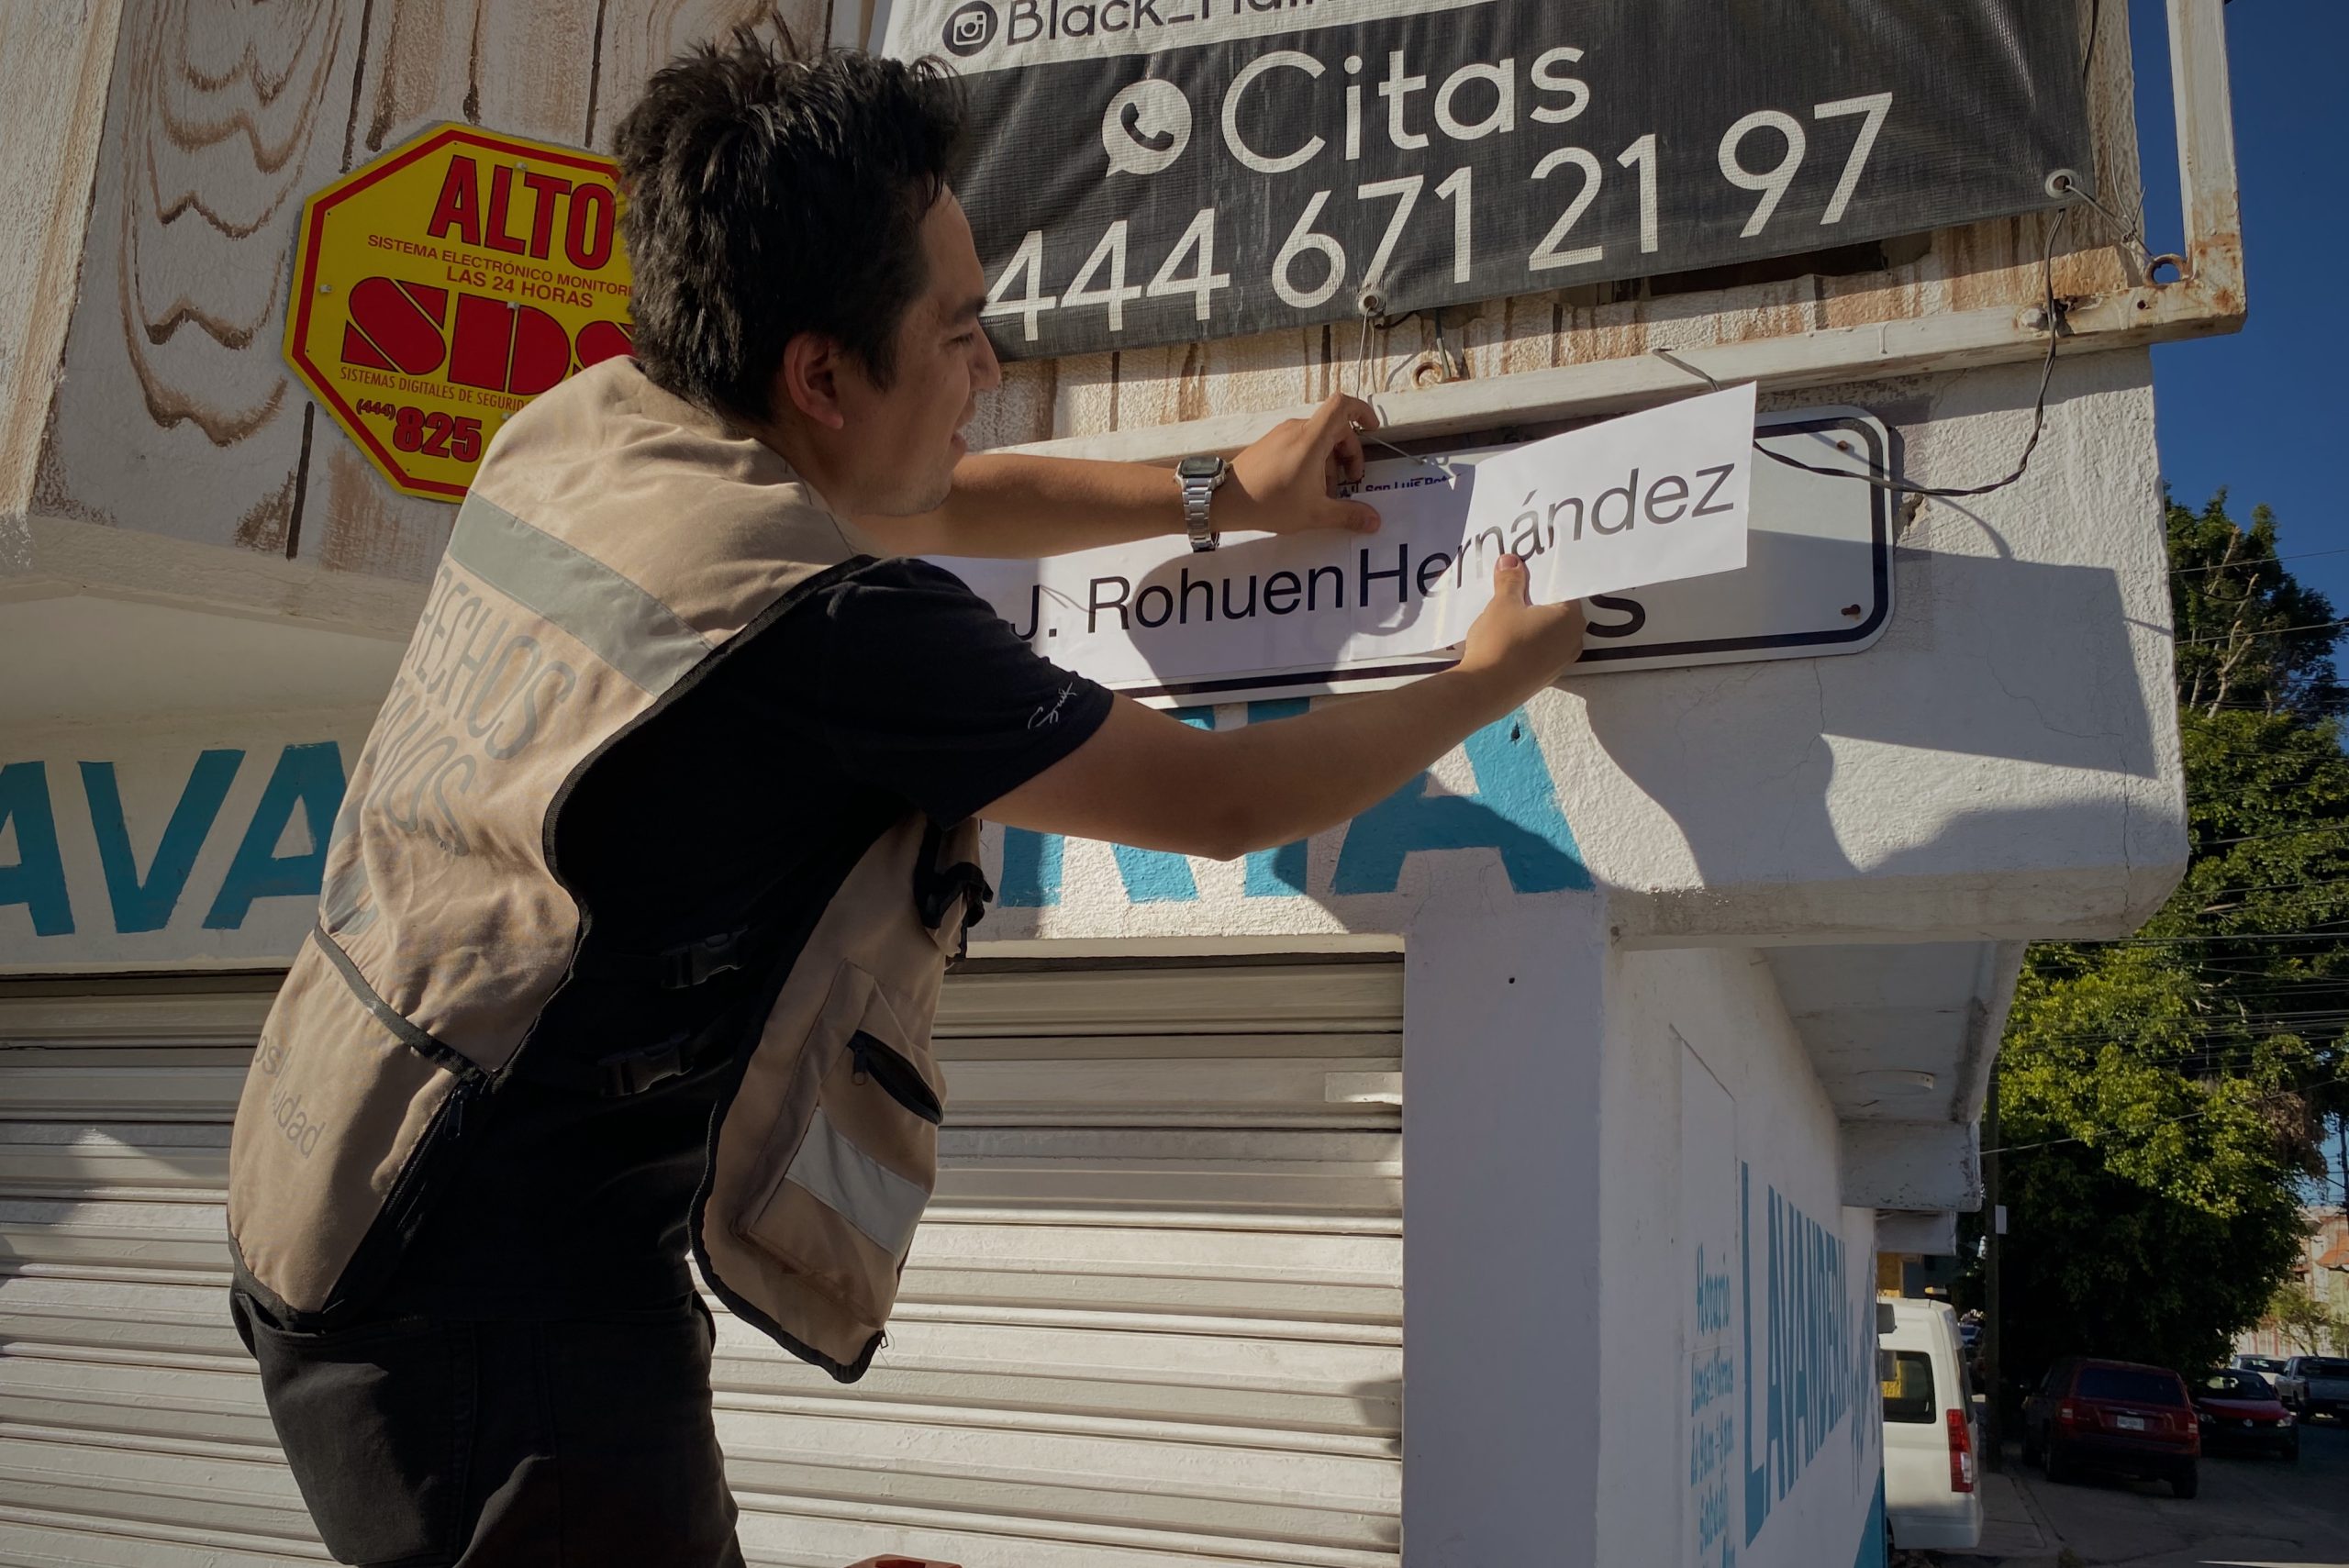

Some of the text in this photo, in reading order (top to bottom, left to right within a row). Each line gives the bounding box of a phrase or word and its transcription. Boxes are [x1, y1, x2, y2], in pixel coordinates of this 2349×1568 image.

[1221, 47, 1590, 173] Citas
[428, 154, 617, 270] ALTO
[982, 92, 1893, 341] 444 671 21 97
[368, 235, 438, 261] SISTEMA
[442, 250, 552, 283] ELECTRÓNICO
[446, 266, 594, 309] LAS 24 HORAS
[340, 367, 529, 412] SISTEMAS DIGITALES DE SEGURID
[393, 406, 482, 462] 825
[1010, 584, 1057, 641] J.
[1742, 1160, 1851, 1550] LAVANDERIA
